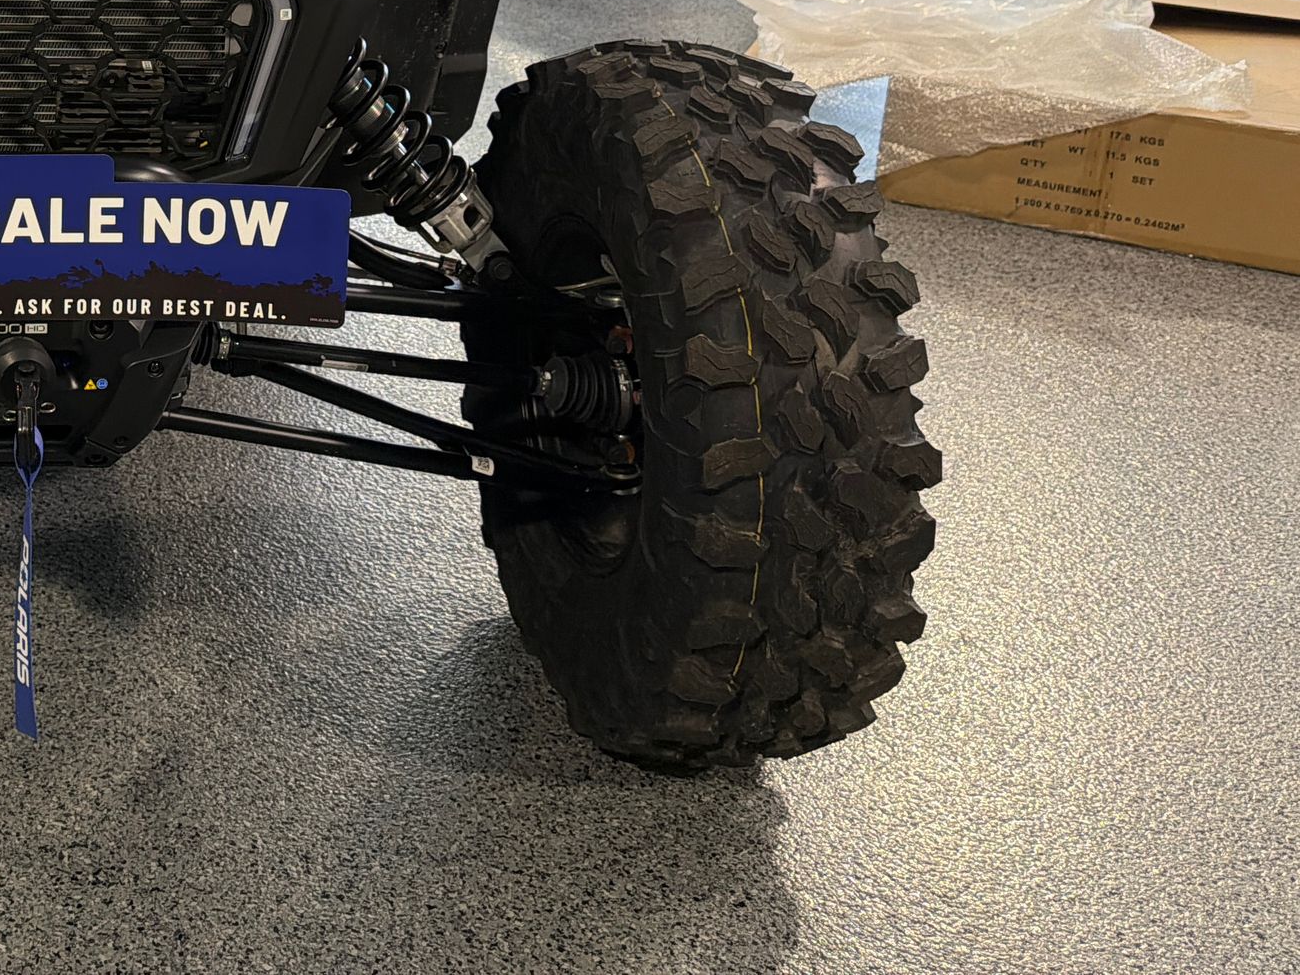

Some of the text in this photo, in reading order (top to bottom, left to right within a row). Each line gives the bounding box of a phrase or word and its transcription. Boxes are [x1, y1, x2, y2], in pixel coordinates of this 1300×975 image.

[1140, 135, 1164, 147] KGS
[1068, 145, 1086, 155] WT
[1106, 150, 1126, 161] 11.5
[1134, 155, 1160, 167] KGS
[1020, 157, 1048, 168] Q'TY
[1132, 175, 1155, 186] SET
[142, 197, 289, 248] NOW
[14, 299, 53, 315] ASK
[64, 299, 101, 315] FOR
[112, 299, 151, 315] OUR
[162, 299, 214, 317] BEST
[225, 301, 287, 320] DEAL.
[26, 324, 47, 333] HD
[16, 534, 30, 688] POLARIS
